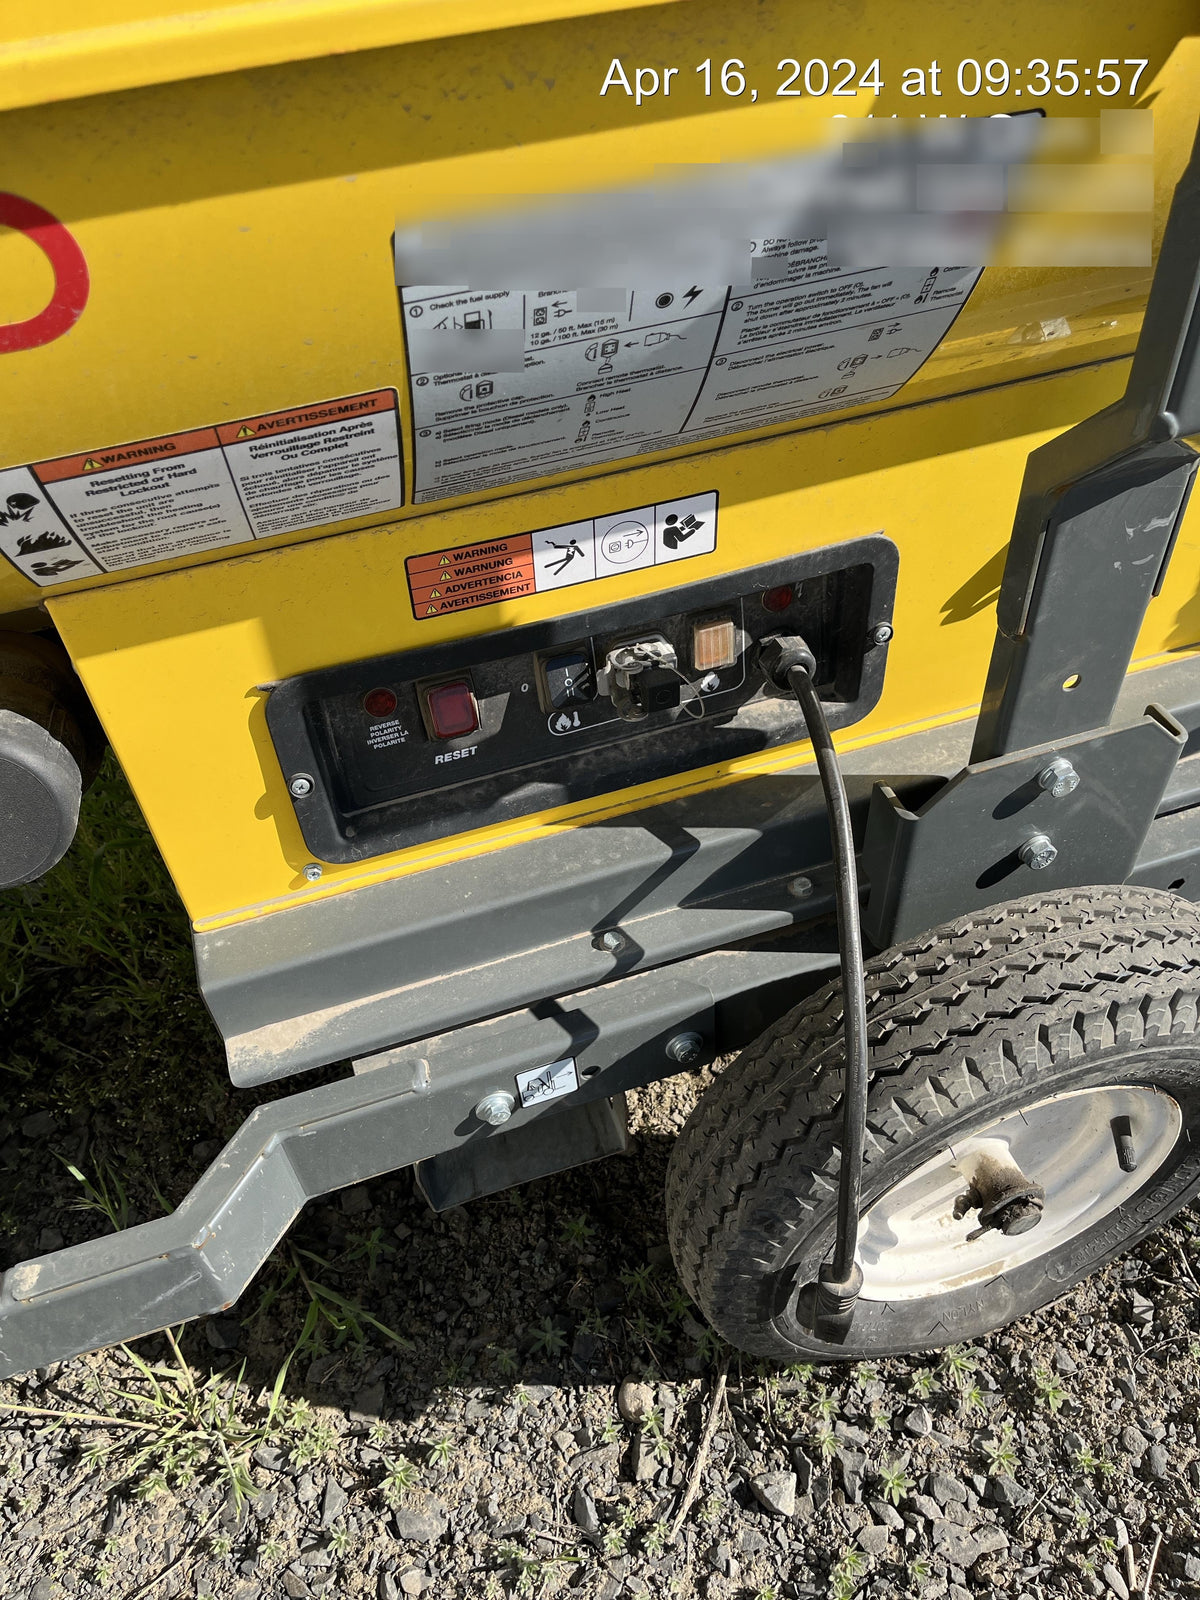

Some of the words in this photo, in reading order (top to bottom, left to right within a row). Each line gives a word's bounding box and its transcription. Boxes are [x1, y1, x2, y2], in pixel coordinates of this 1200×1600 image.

[429, 300, 454, 311] Check
[455, 298, 468, 306] the
[469, 294, 483, 303] fuel
[484, 288, 511, 300] supply
[557, 326, 567, 334] 50
[576, 322, 592, 330] Max
[593, 318, 605, 327] (15
[605, 316, 615, 324] m)
[558, 332, 571, 340] 100
[580, 328, 596, 336] Max
[597, 325, 608, 333] (30
[609, 322, 618, 330] m)
[256, 398, 378, 432] AVERTISSEMENT
[248, 429, 336, 452] Réinitialisation
[339, 421, 373, 433] Après
[249, 441, 320, 460] Verrouillage
[323, 428, 375, 444] Restreint
[100, 442, 176, 464] WARNING
[300, 441, 349, 456] Complet
[251, 471, 273, 479] trois
[274, 461, 320, 474] tentatives
[322, 447, 382, 463] consécutives
[84, 478, 149, 497] Restricted
[167, 467, 198, 479] Hard
[89, 471, 150, 487] Resetting
[152, 463, 185, 474] From
[79, 507, 108, 516] three
[110, 493, 172, 510] consecutive
[174, 483, 220, 496] attempts
[119, 481, 171, 497] Lockout
[79, 515, 144, 532] troubleshoot
[165, 502, 203, 513] heating
[86, 511, 114, 520] reset
[135, 502, 155, 510] unit
[452, 543, 508, 561] WARNING
[453, 556, 512, 576] WARNUNG
[444, 570, 523, 594] ADVERTENCIA
[440, 582, 531, 610] AVERTISSEMENT
[369, 720, 400, 732] REVERSE
[370, 725, 402, 738] POLARITY
[367, 733, 400, 746] INVERSER
[434, 746, 478, 765] RESET
